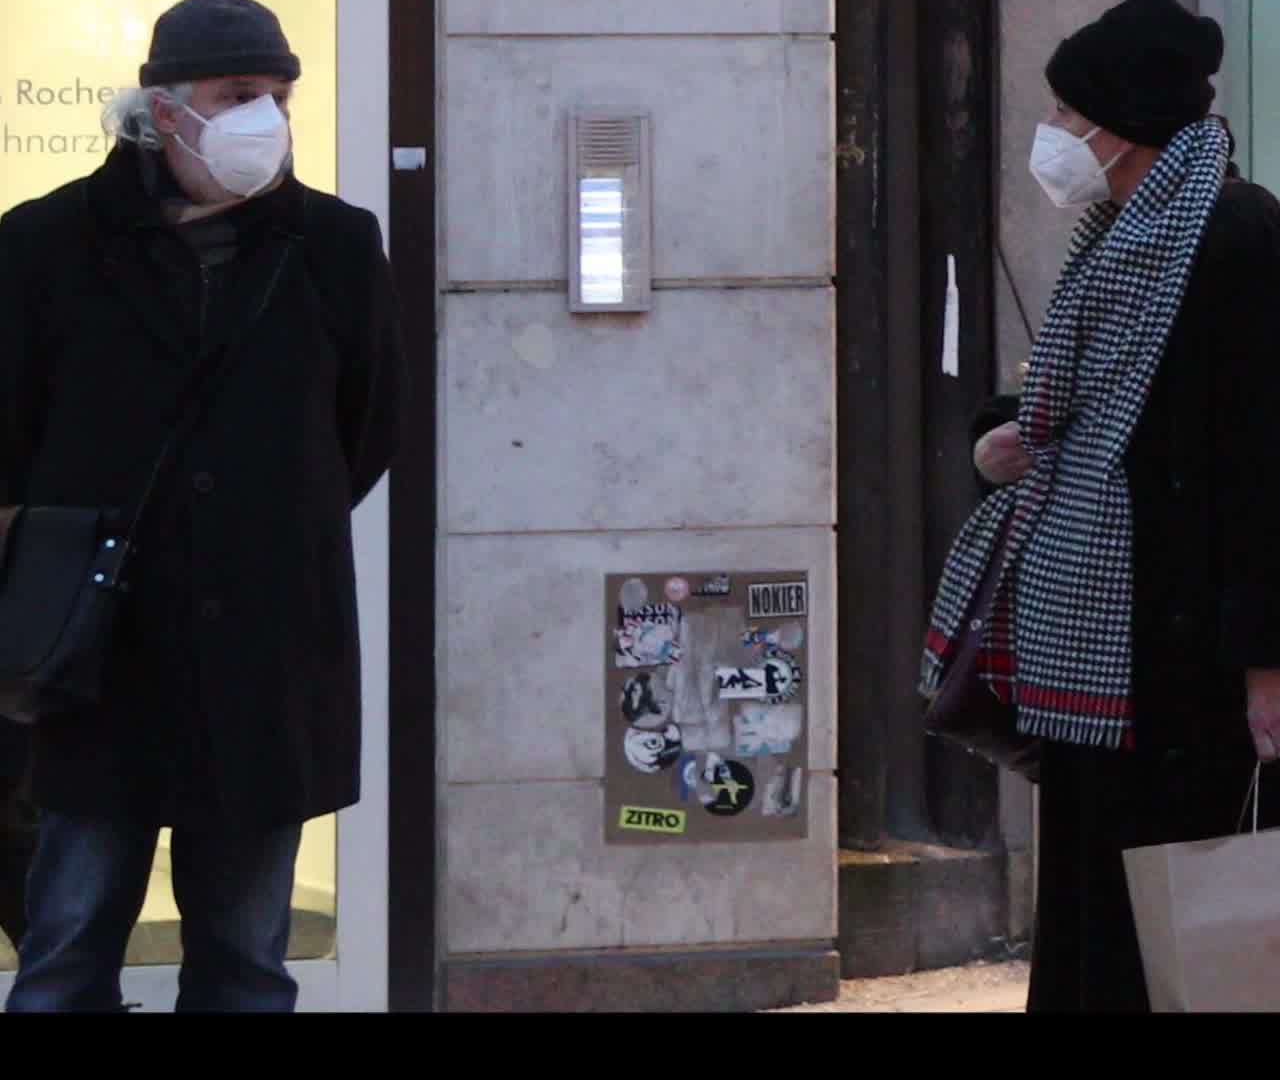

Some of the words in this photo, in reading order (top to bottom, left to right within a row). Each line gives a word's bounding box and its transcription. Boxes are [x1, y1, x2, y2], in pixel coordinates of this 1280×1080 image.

[16, 76, 115, 106] Roche
[751, 585, 806, 615] NOKIER
[624, 809, 681, 829] ZITRO
